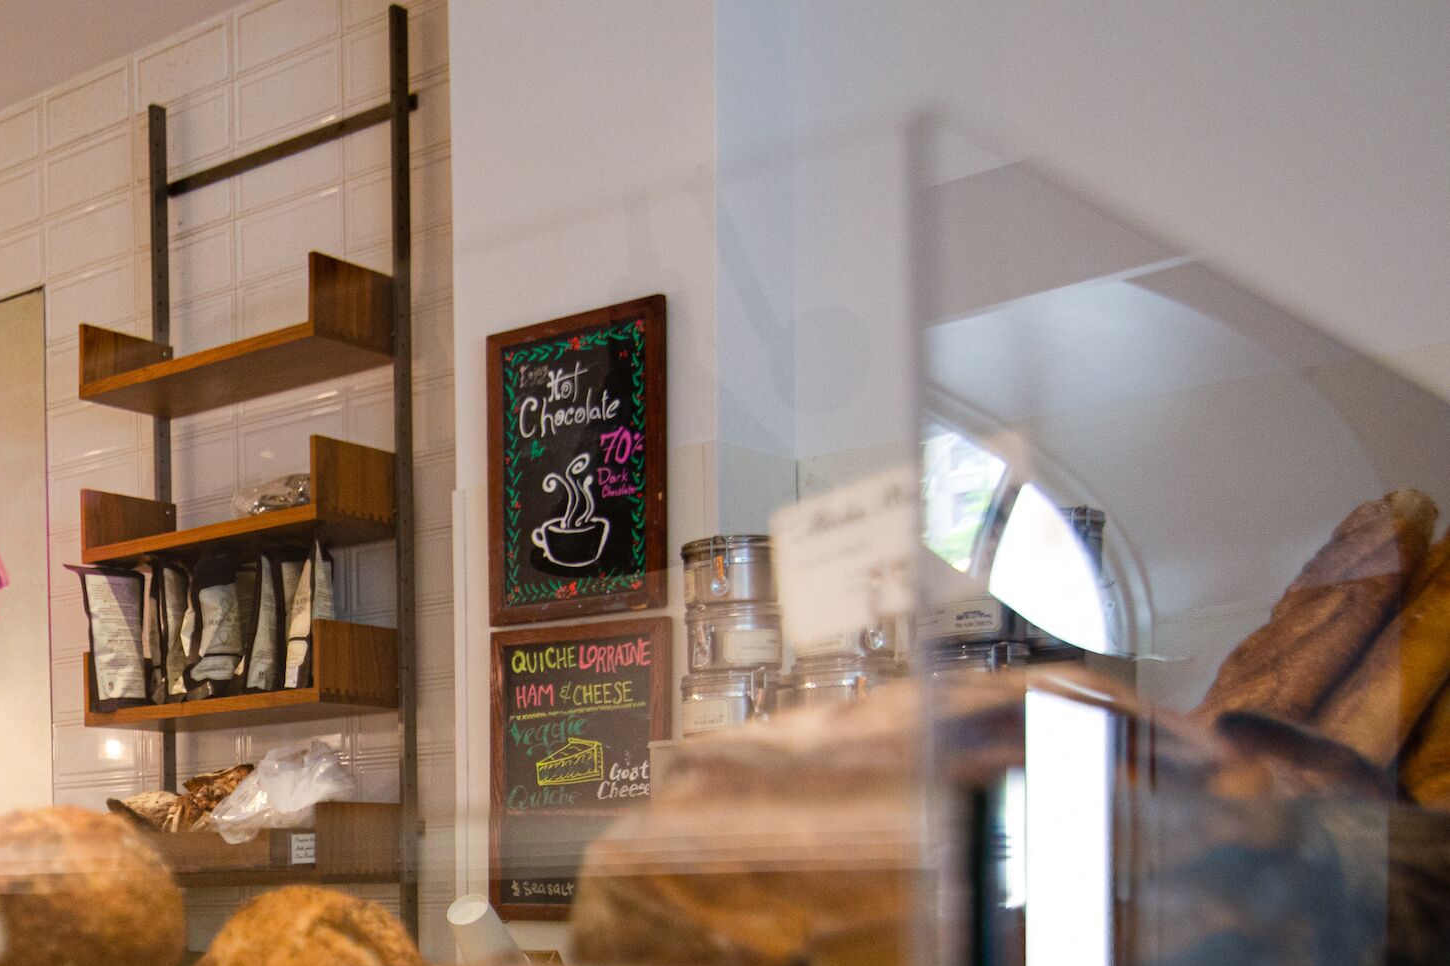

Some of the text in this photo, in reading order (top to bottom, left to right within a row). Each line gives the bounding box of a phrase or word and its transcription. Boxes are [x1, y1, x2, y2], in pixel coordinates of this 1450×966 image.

[546, 361, 589, 402] Hot
[519, 387, 621, 439] Chocolate
[600, 425, 645, 465] 70%
[597, 467, 629, 486] Dark
[511, 638, 651, 674] QUICHE LORRAINE
[515, 680, 634, 709] HAM & CHEESE
[509, 714, 588, 757] Veggie
[609, 760, 650, 782] Goat
[506, 785, 576, 810] Quiche
[597, 780, 650, 800] Cheese
